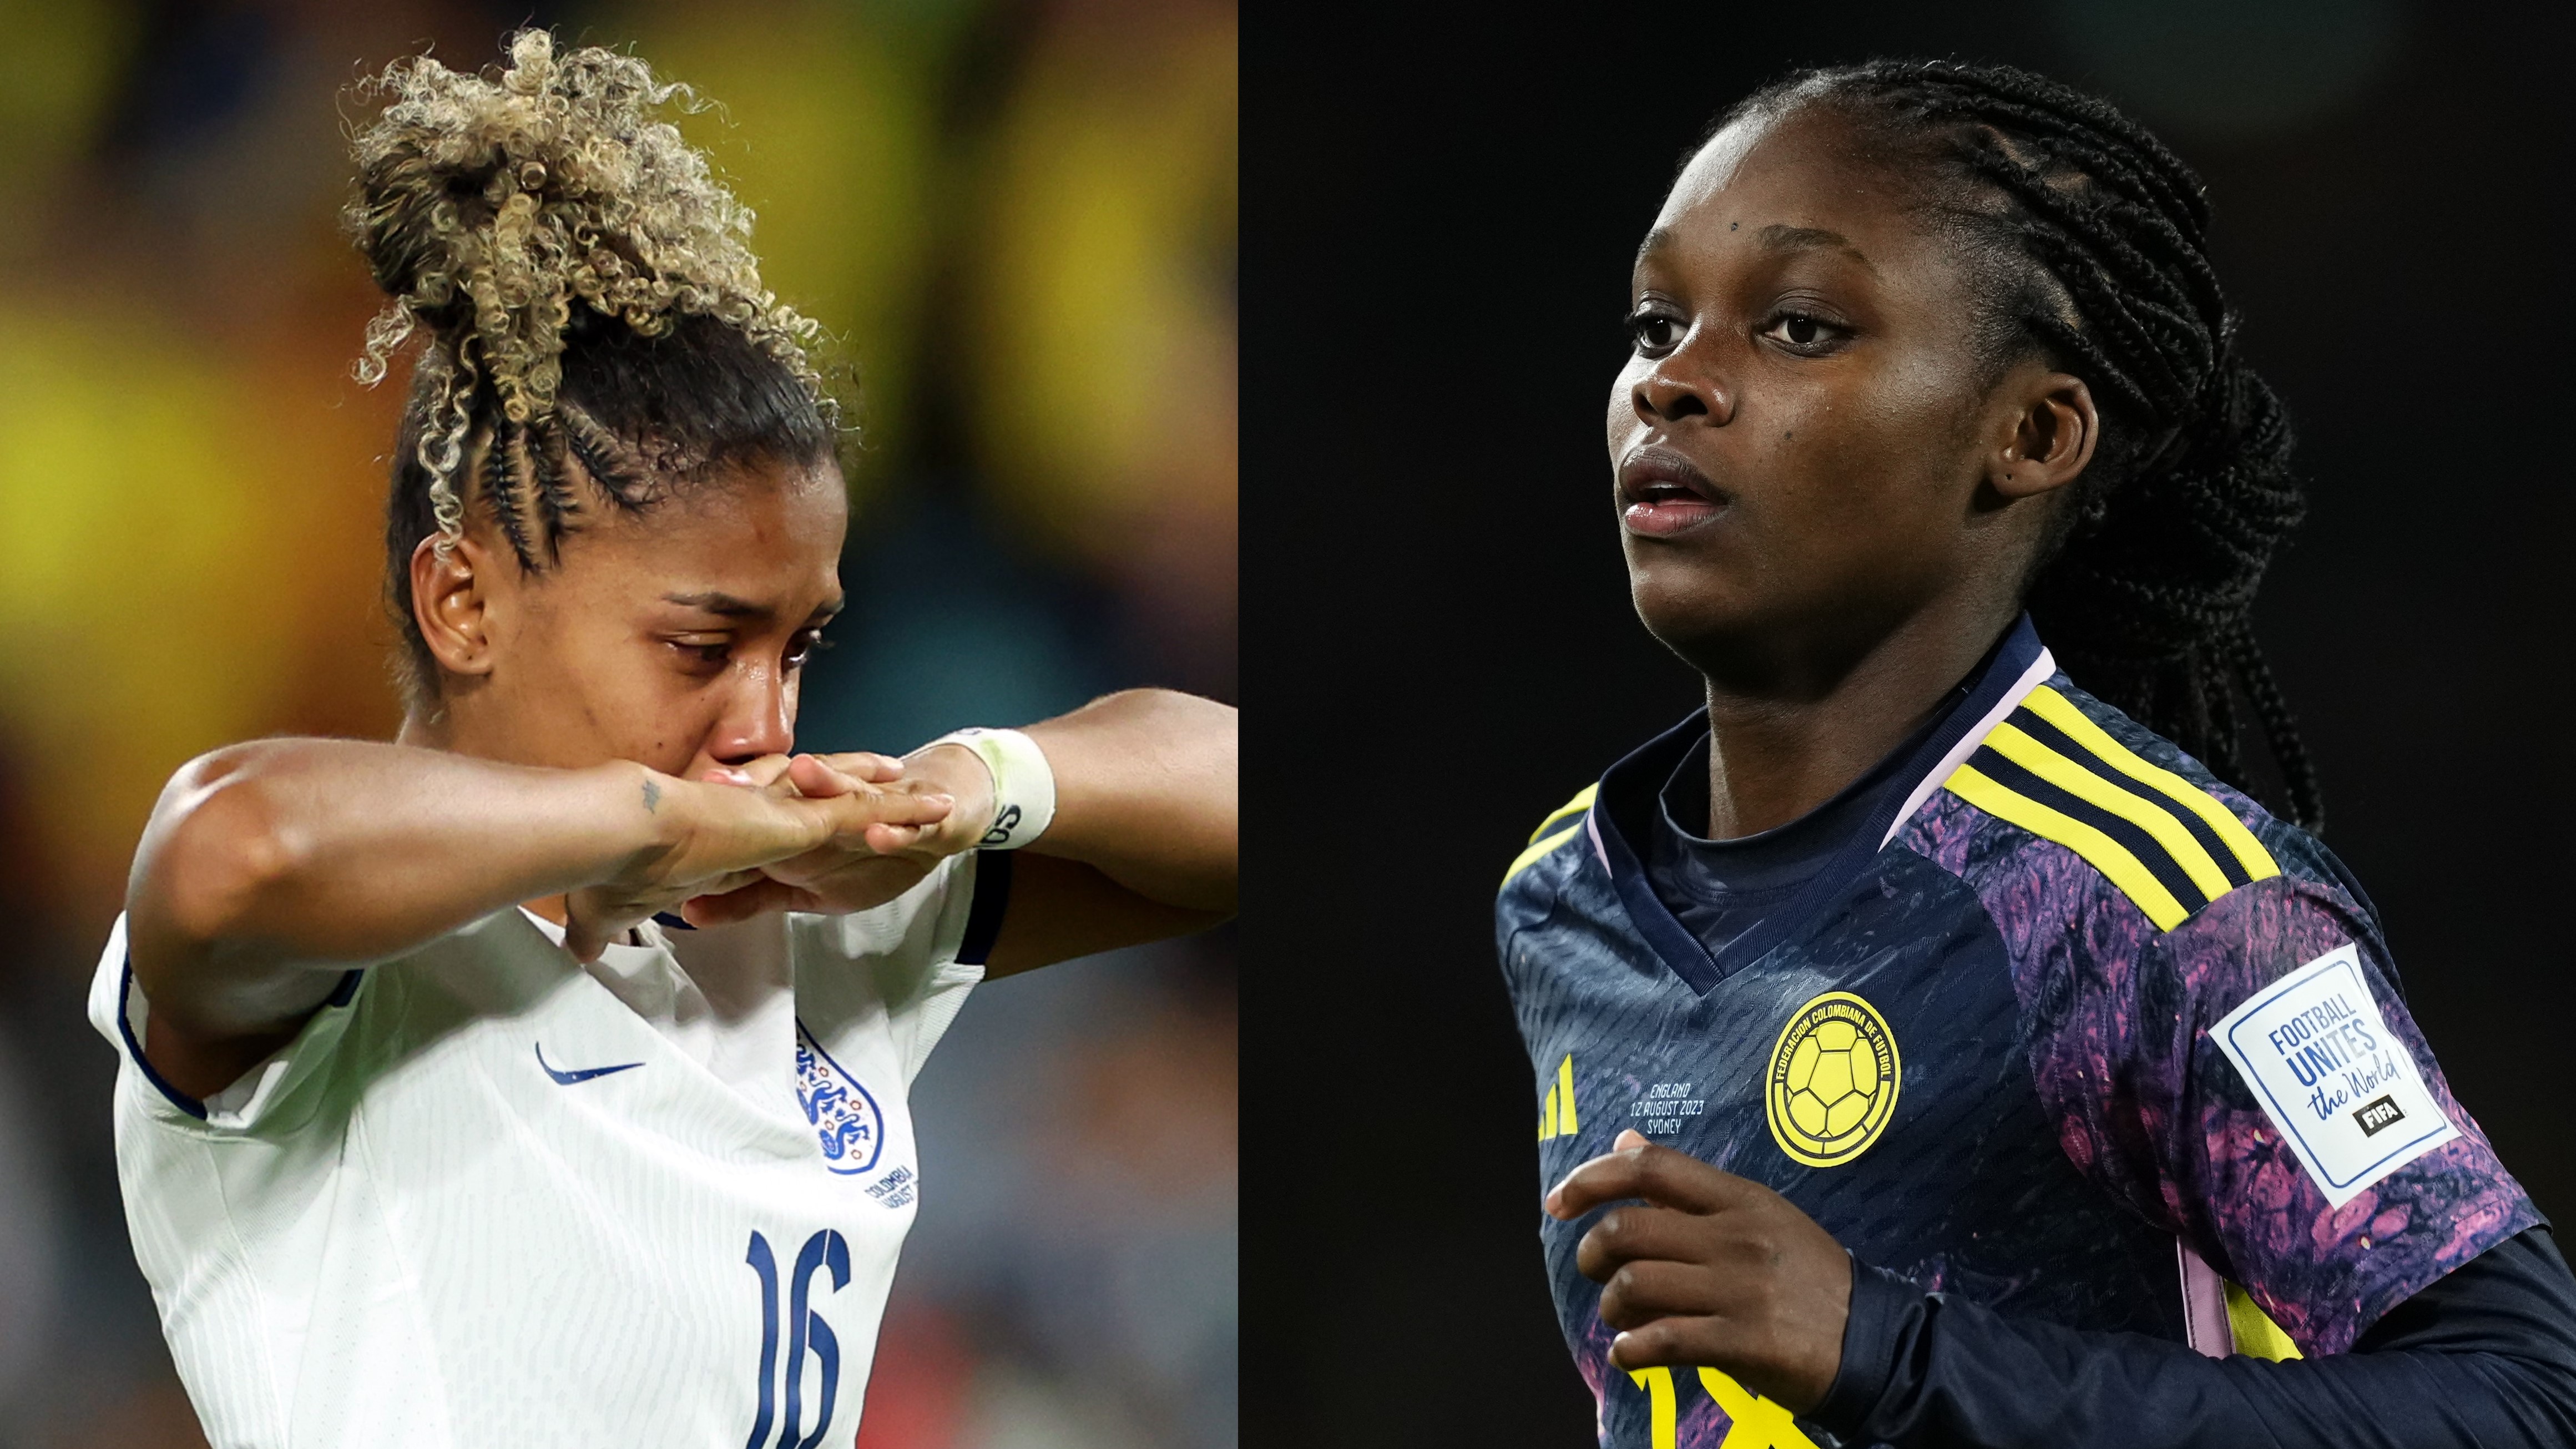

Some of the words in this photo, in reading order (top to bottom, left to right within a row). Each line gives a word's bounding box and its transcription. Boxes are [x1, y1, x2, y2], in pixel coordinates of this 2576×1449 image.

[1776, 1017, 1812, 1080] FEDERACION
[1812, 1004, 1866, 1027] COLOMBIANA
[1865, 1020, 1877, 1038] DE
[1873, 1035, 1891, 1078] FUTBOL
[2269, 993, 2356, 1055] FOOTBALL
[2286, 1018, 2377, 1087] UNITES
[1630, 1102, 1643, 1117] 12
[1643, 1100, 1679, 1116] AUGUST
[1680, 1100, 1704, 1115] 2023
[1650, 1083, 1691, 1099] ENGLAND
[2307, 1086, 2348, 1120] the
[2342, 1049, 2401, 1098] World
[1647, 1118, 1681, 1134] SYDNEY
[2361, 1102, 2398, 1130] FIFA
[746, 1228, 851, 1449] 16
